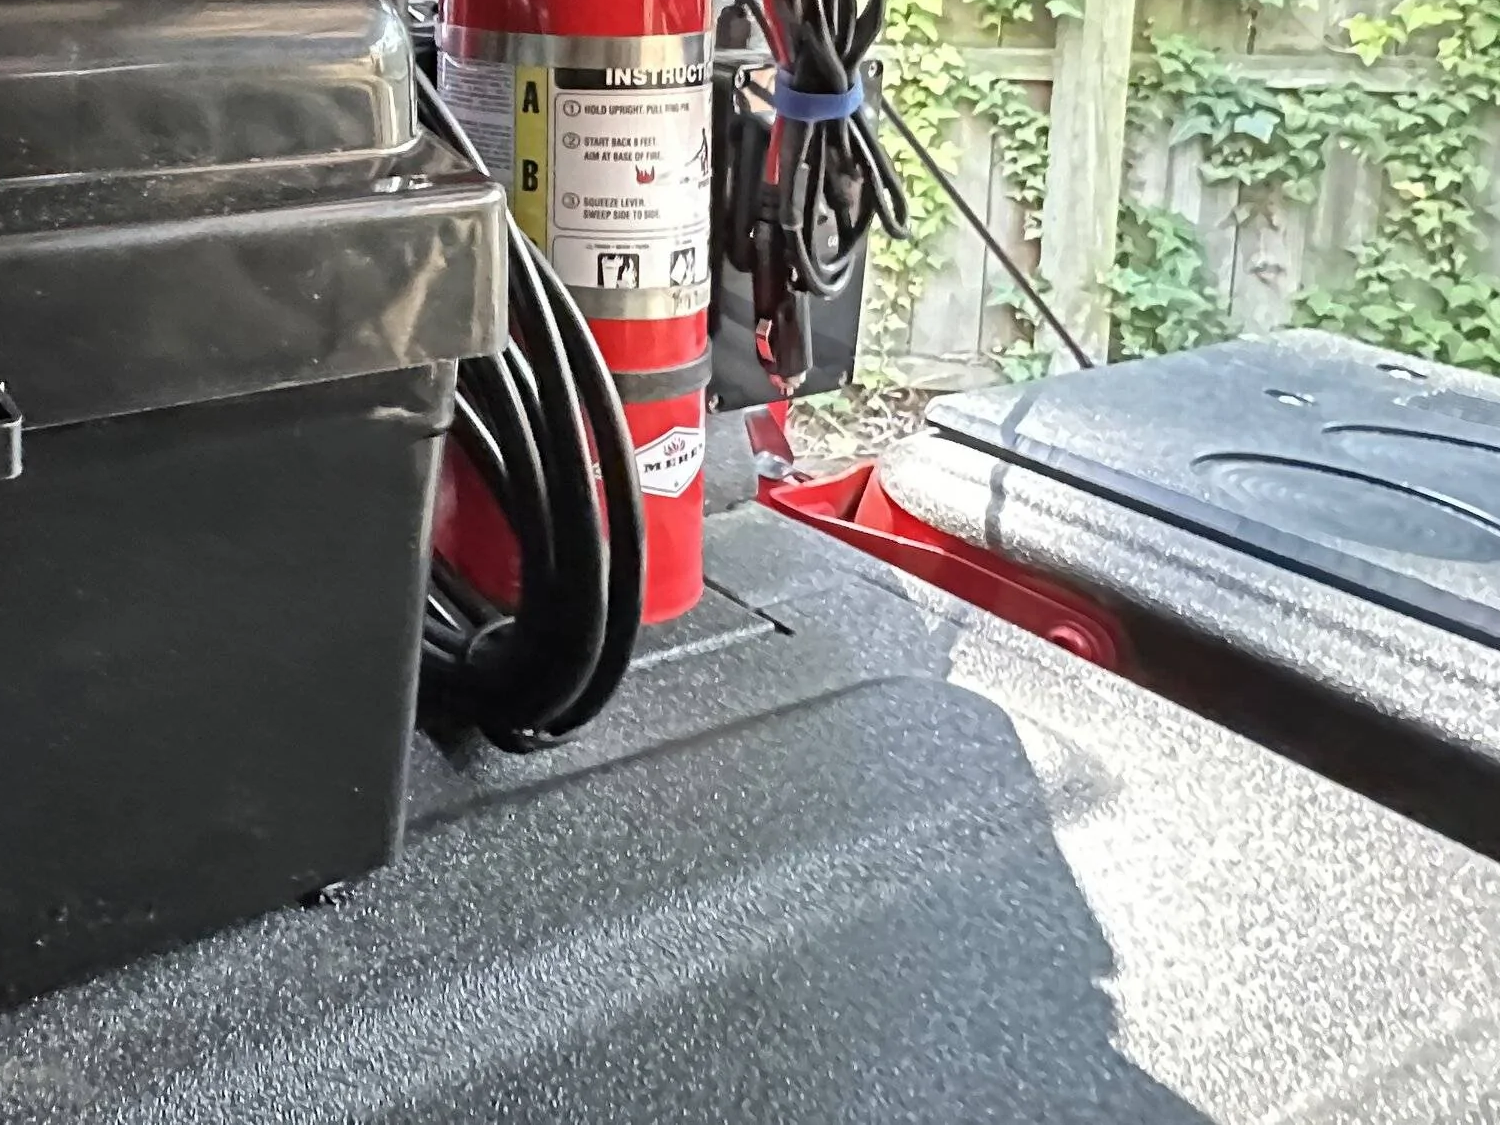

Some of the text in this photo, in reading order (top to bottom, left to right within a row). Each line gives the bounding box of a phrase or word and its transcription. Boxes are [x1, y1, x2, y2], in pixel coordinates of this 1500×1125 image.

[605, 64, 705, 86] INSTRUCT
[522, 81, 540, 114] A
[584, 104, 607, 115] HOLD
[584, 137, 610, 147] START
[611, 137, 631, 148] BACK
[584, 151, 600, 161] AIM
[601, 151, 611, 161] AT
[613, 151, 633, 162] BASE
[634, 151, 644, 162] OF
[522, 159, 539, 192] B
[583, 196, 618, 208] SQUEEZE
[583, 209, 612, 220] SWEEP
[613, 210, 630, 220] SIDE
[632, 210, 643, 220] TO
[644, 441, 703, 473] MERE
